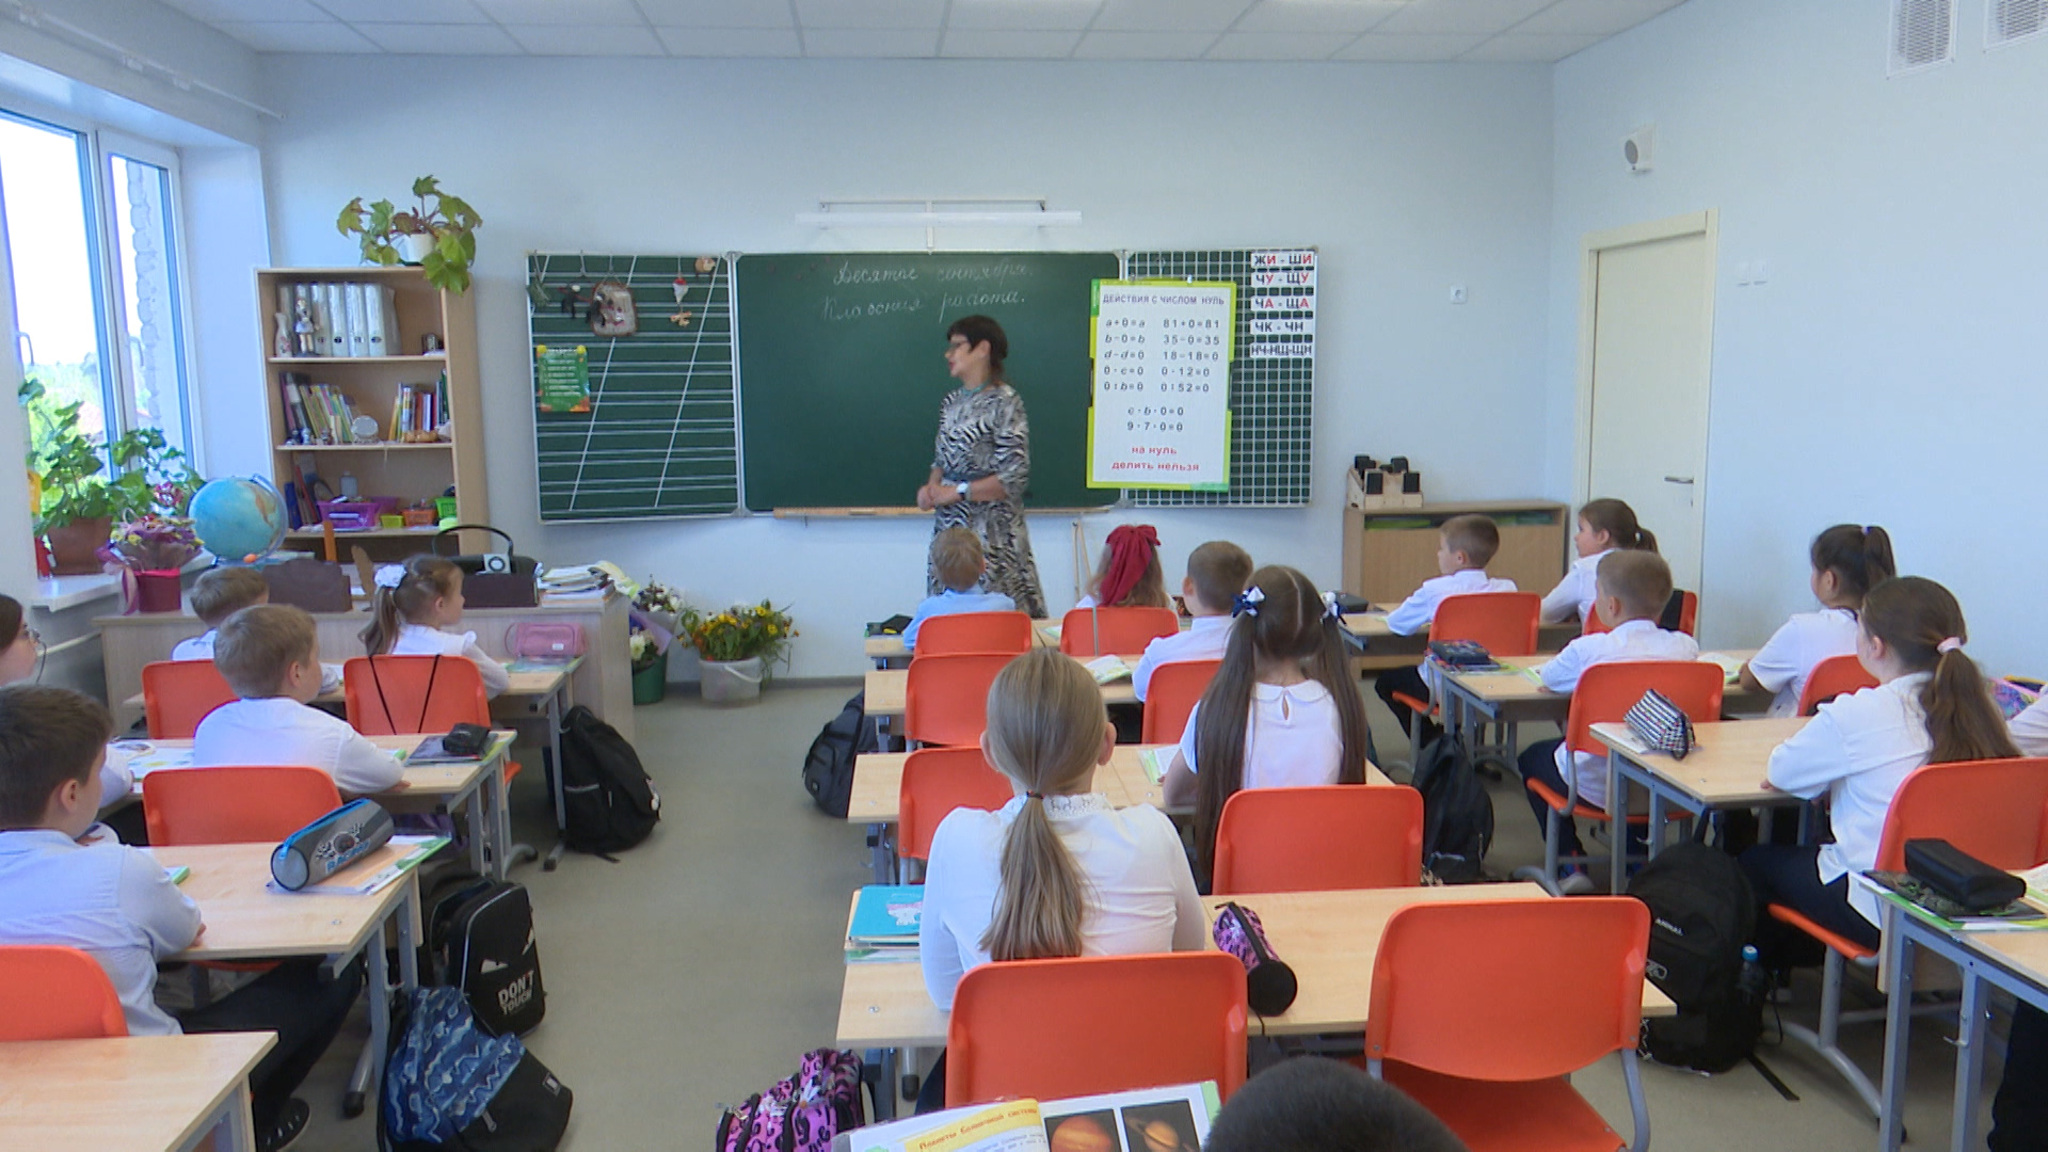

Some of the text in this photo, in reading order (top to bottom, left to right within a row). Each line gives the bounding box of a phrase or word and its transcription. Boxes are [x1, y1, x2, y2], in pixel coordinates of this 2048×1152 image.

[1254, 255, 1276, 265] ЖИ
[1289, 254, 1312, 265] ШИ
[1256, 274, 1274, 285] ЧУ
[1286, 272, 1309, 285] ЩУ
[1102, 293, 1149, 304] ДЕЙСТВИЯ
[1160, 295, 1197, 305] ЧИСЛОМ
[1201, 296, 1225, 305] НУЛЬ
[1255, 298, 1274, 309] ЧА
[1255, 321, 1273, 332] ЧК
[1284, 321, 1304, 332] ЧН
[1131, 446, 1177, 456] на нуль
[1111, 461, 1200, 471] делить нельзя
[498, 970, 534, 1004] DON'T
[501, 989, 532, 1015] TOUCH
